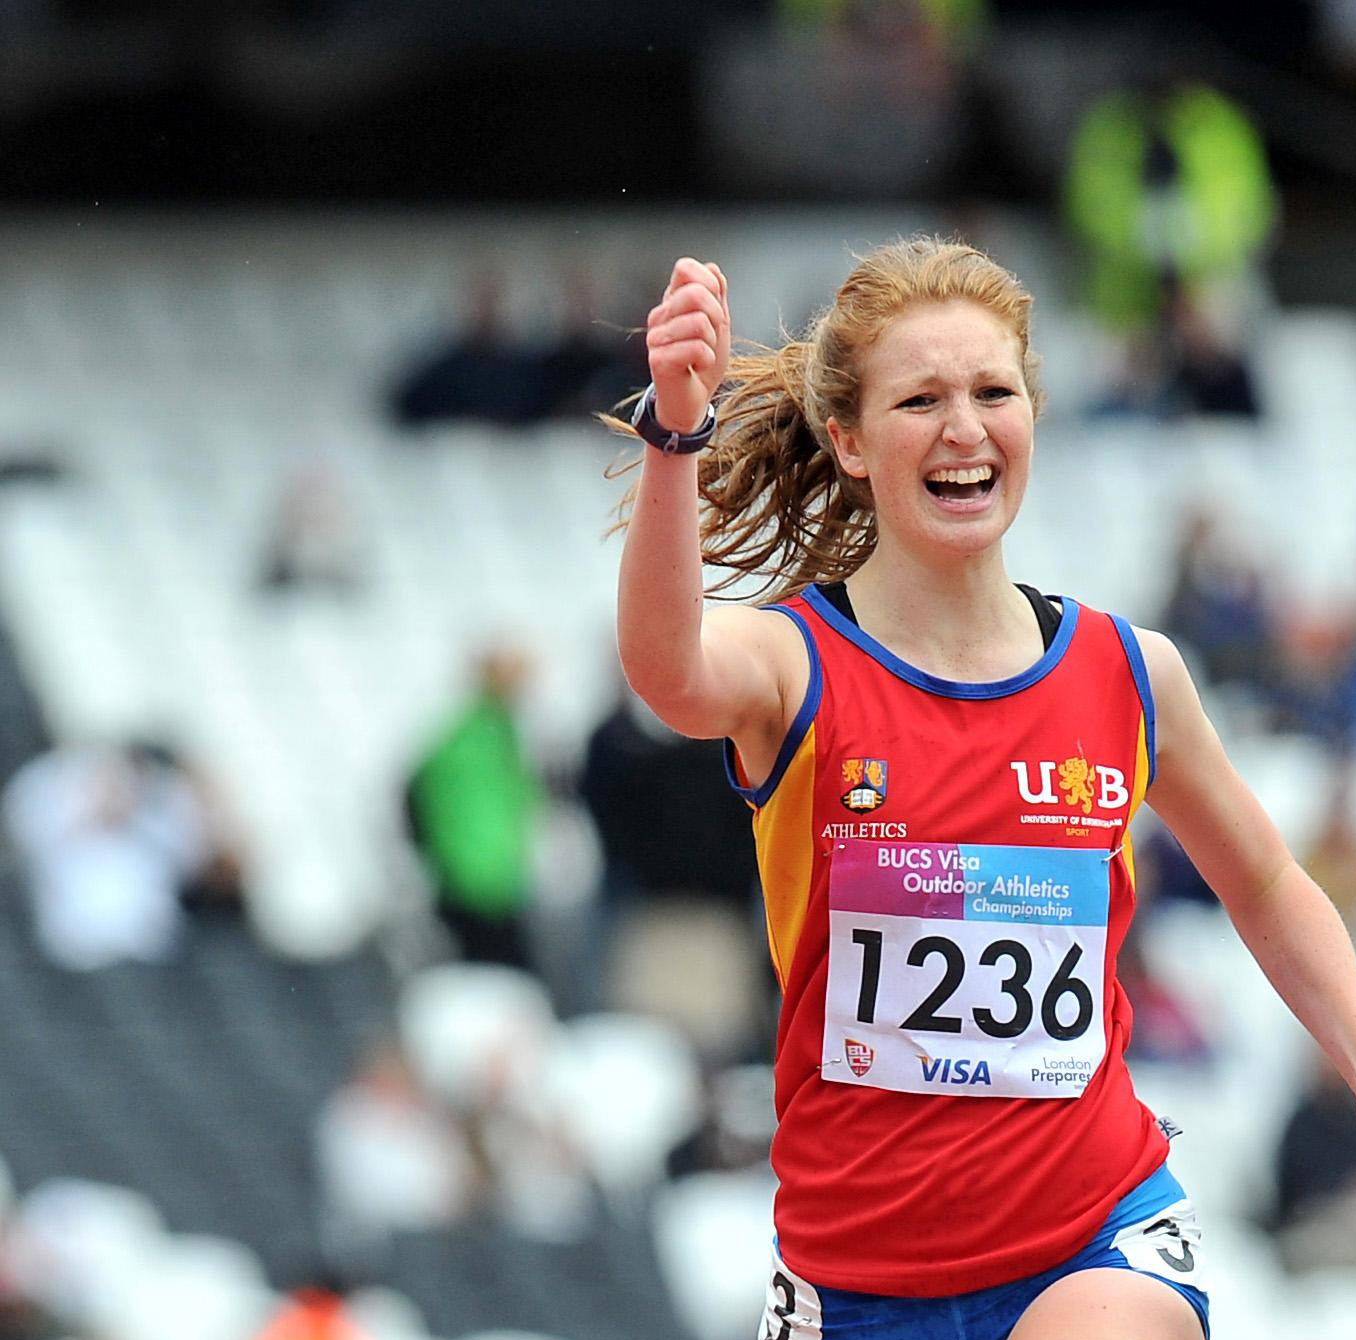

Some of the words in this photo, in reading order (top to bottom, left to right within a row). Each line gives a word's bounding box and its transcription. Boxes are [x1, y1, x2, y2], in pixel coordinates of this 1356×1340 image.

[821, 822, 908, 839] ATHLETICS
[1065, 827, 1090, 837] SPORT
[877, 847, 932, 869] BUCS
[937, 849, 980, 871] Visa
[903, 872, 986, 894] Outdoor
[990, 875, 1070, 898] Athletics
[972, 898, 1073, 920] Championships
[851, 928, 1094, 1042] 1236
[917, 1055, 992, 1086] VISA
[1043, 1057, 1092, 1070] London
